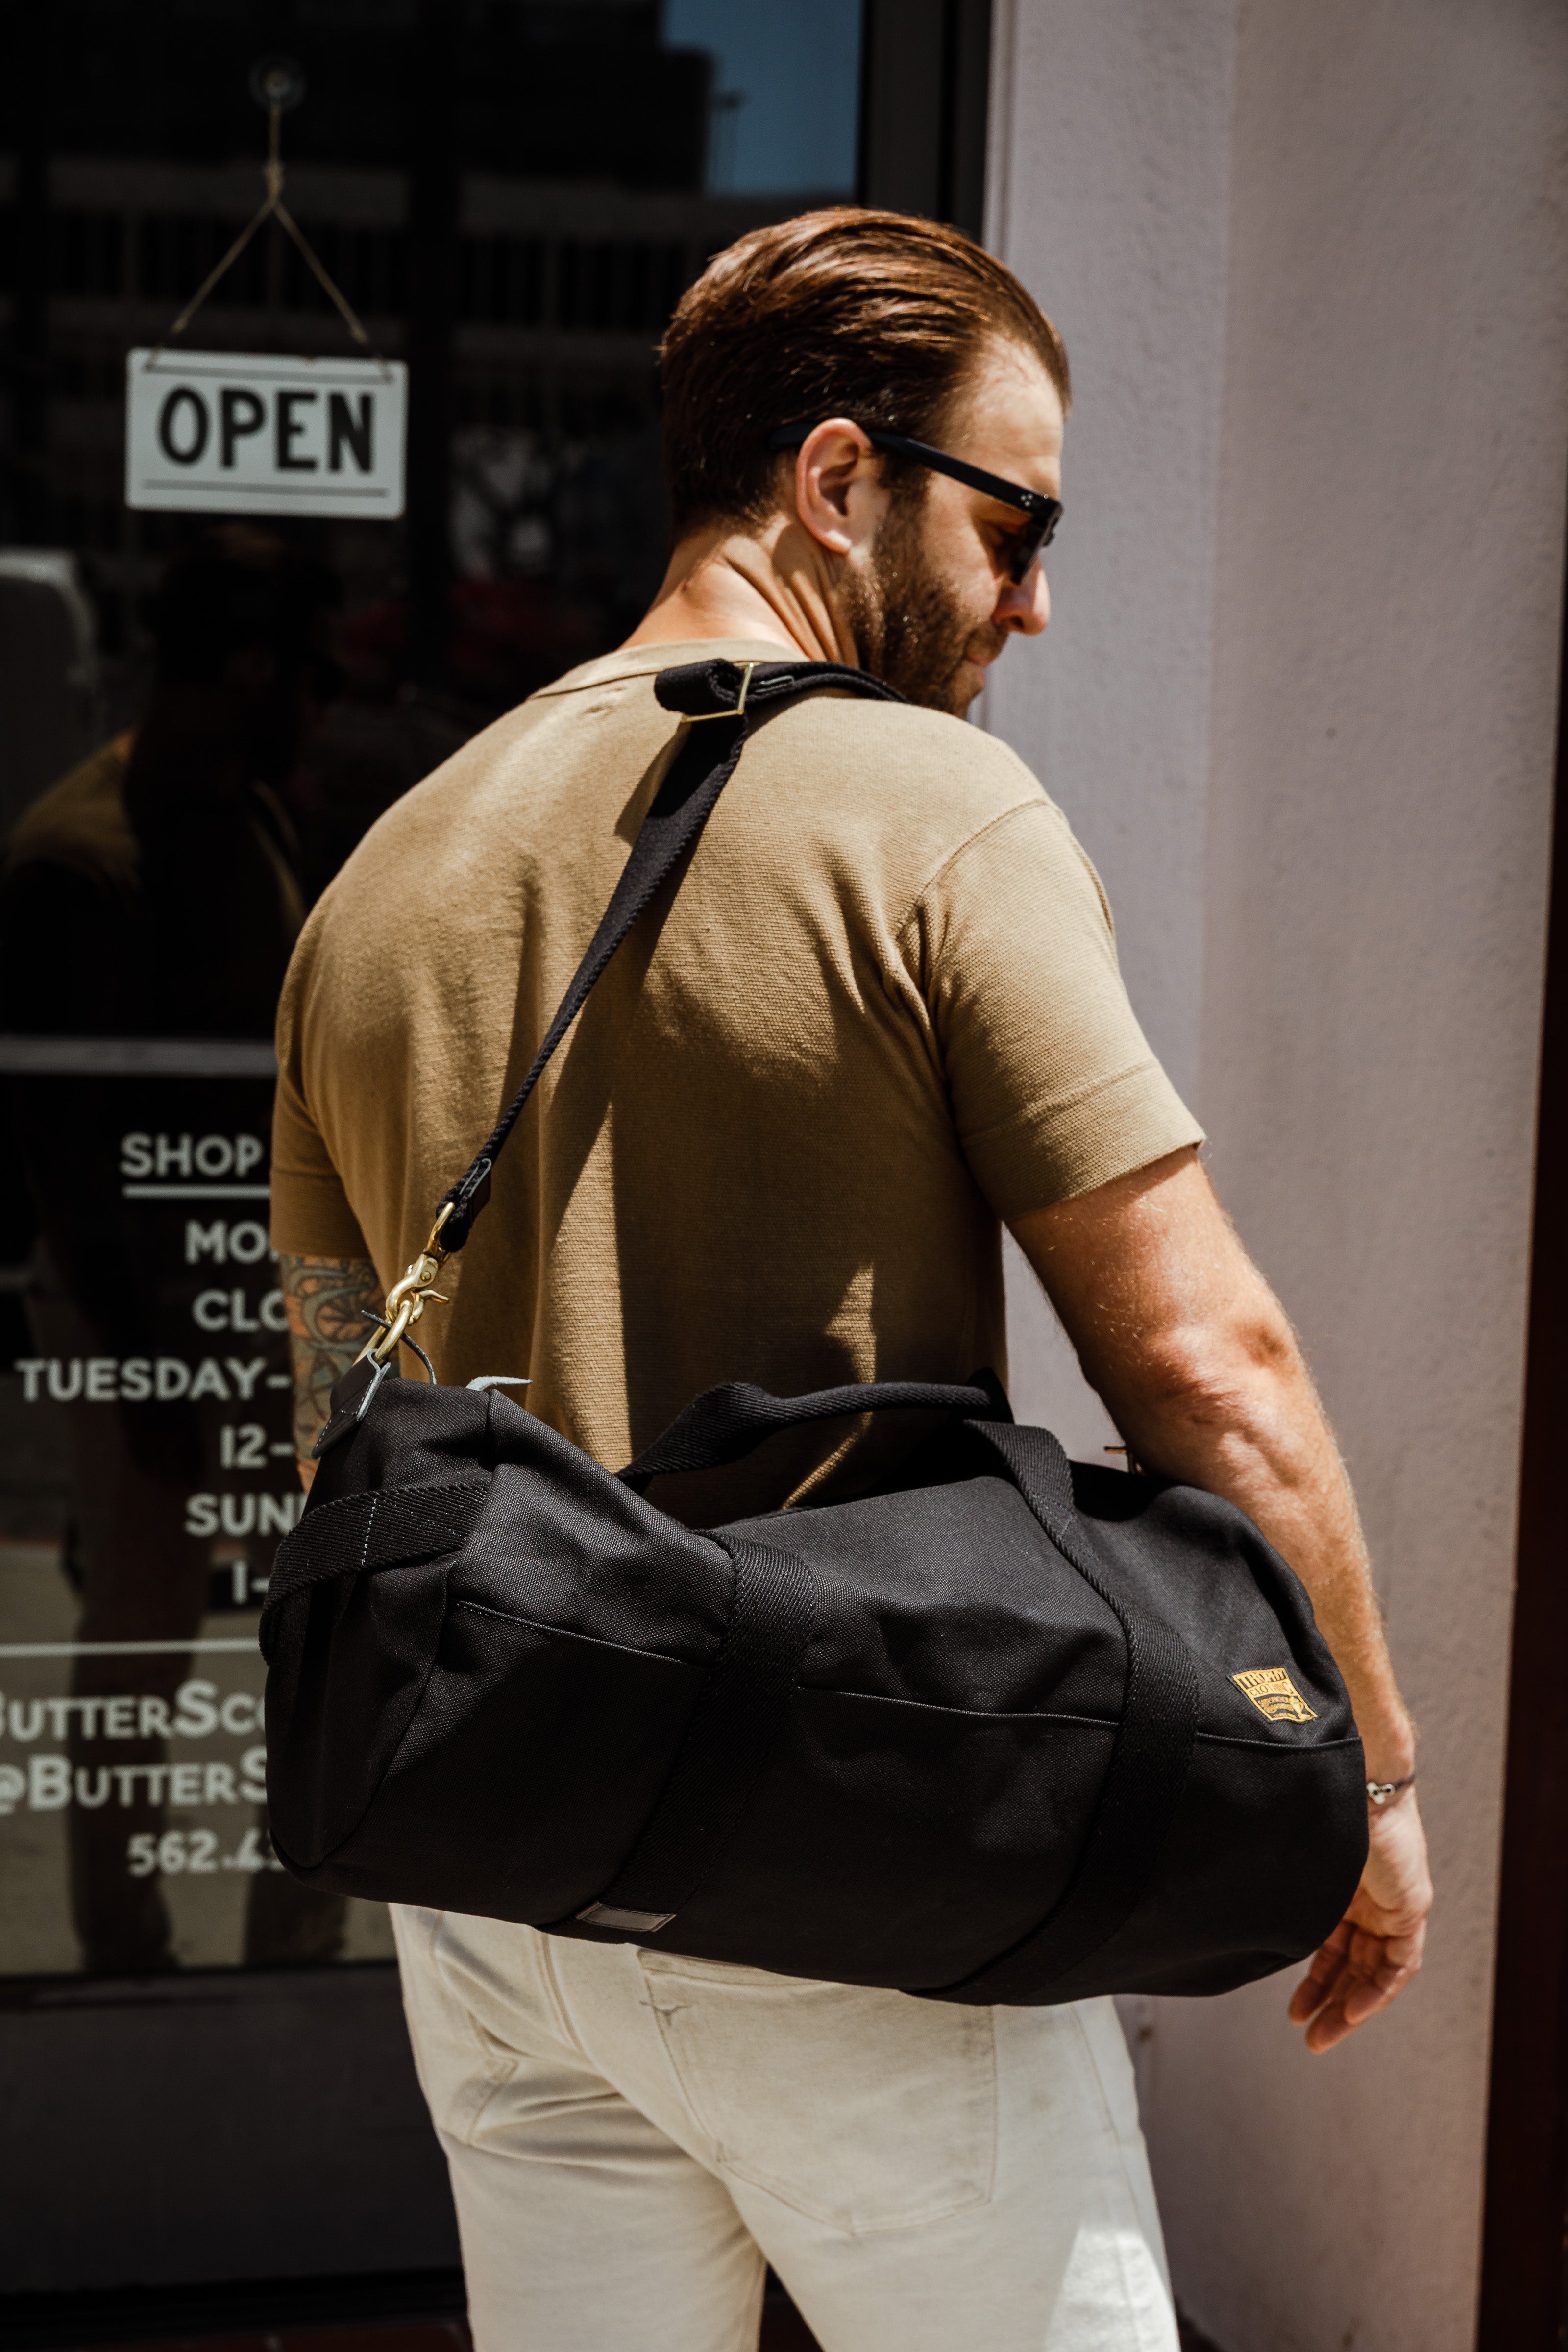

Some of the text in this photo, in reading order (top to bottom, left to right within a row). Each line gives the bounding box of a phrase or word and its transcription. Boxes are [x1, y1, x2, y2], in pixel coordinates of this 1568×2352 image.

[157, 384, 374, 473] OPEN
[119, 1131, 265, 1176] SHOP
[183, 1218, 279, 1265] MO
[14, 1357, 292, 1402] TUESDAY-
[220, 1423, 295, 1469] 12-
[1235, 1669, 1287, 1690] TROPHY
[0, 1678, 265, 1743] UTTERSC
